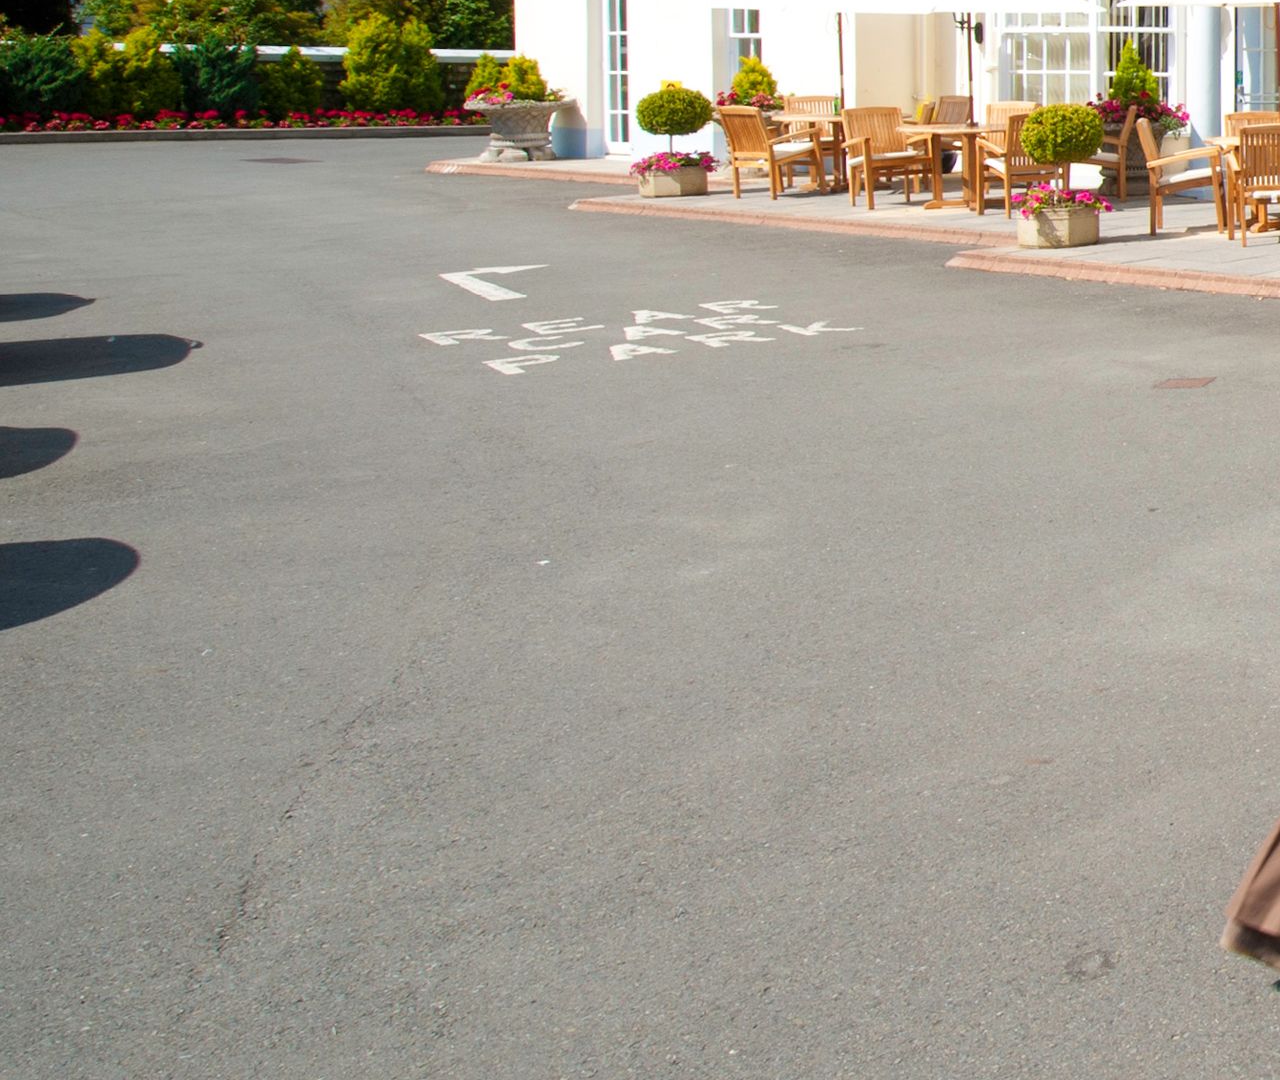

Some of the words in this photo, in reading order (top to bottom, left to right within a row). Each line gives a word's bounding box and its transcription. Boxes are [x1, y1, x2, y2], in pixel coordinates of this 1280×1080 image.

[418, 300, 779, 346] REAR
[507, 314, 780, 351] CAR
[481, 320, 865, 376] PARK
